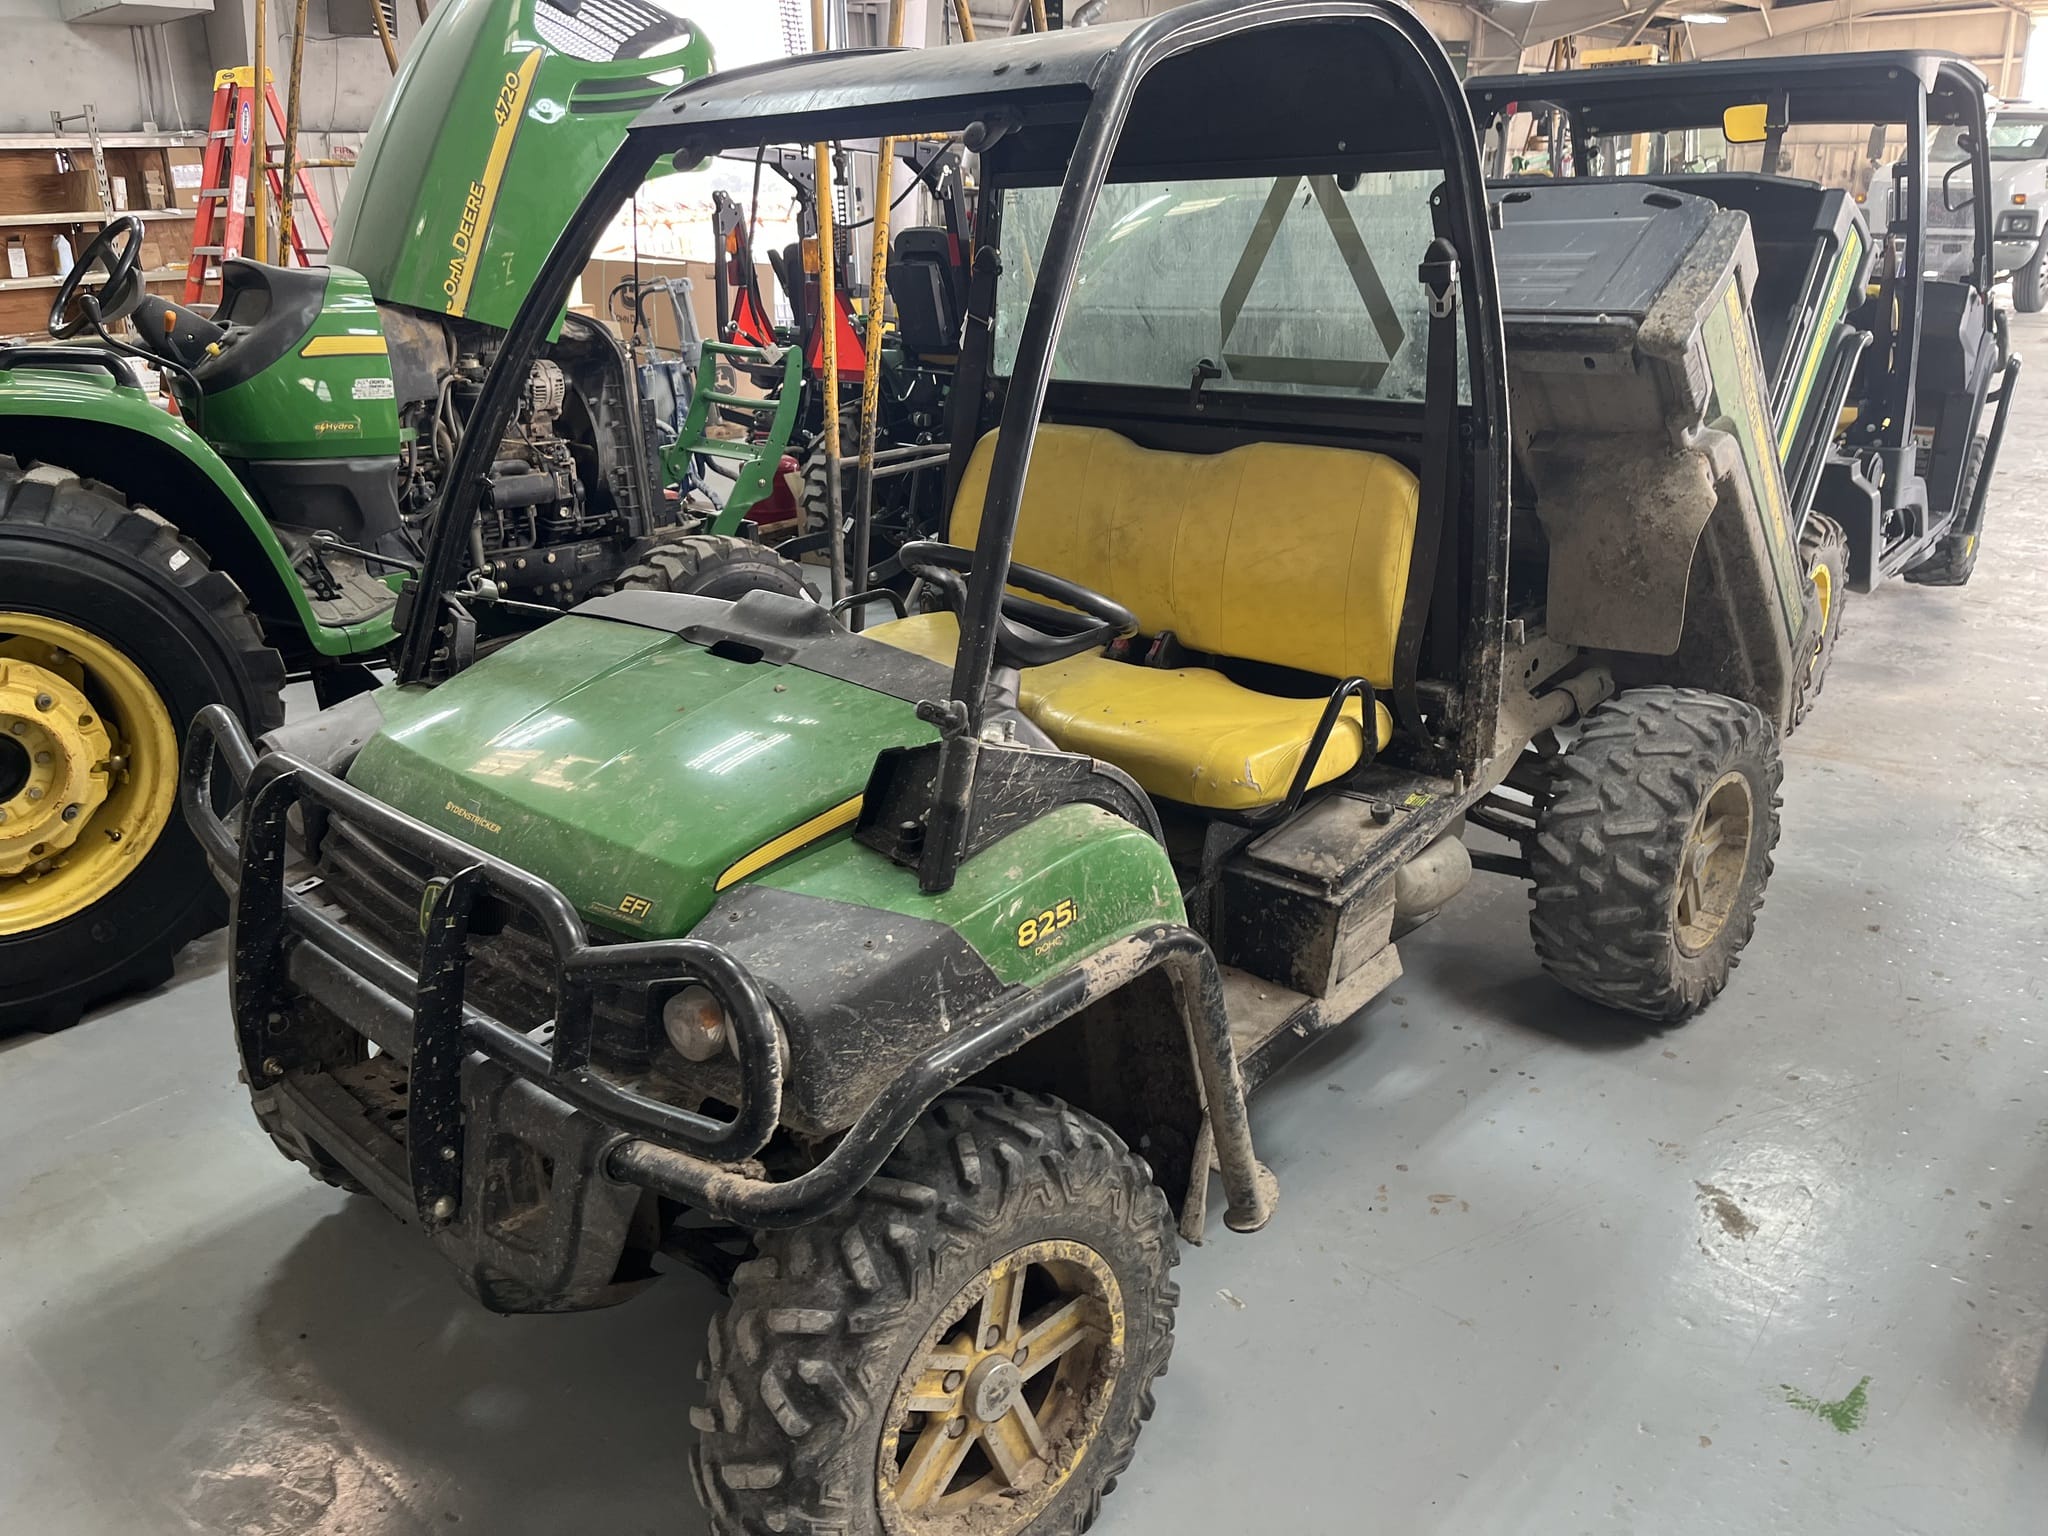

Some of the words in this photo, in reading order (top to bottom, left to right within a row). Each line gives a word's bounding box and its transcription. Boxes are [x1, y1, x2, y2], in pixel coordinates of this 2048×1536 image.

[494, 71, 520, 127] 4720
[452, 180, 486, 254] DEERE
[444, 800, 502, 834] SYDENSTRICKER
[618, 894, 652, 919] EFI
[1017, 897, 1078, 948] 825i
